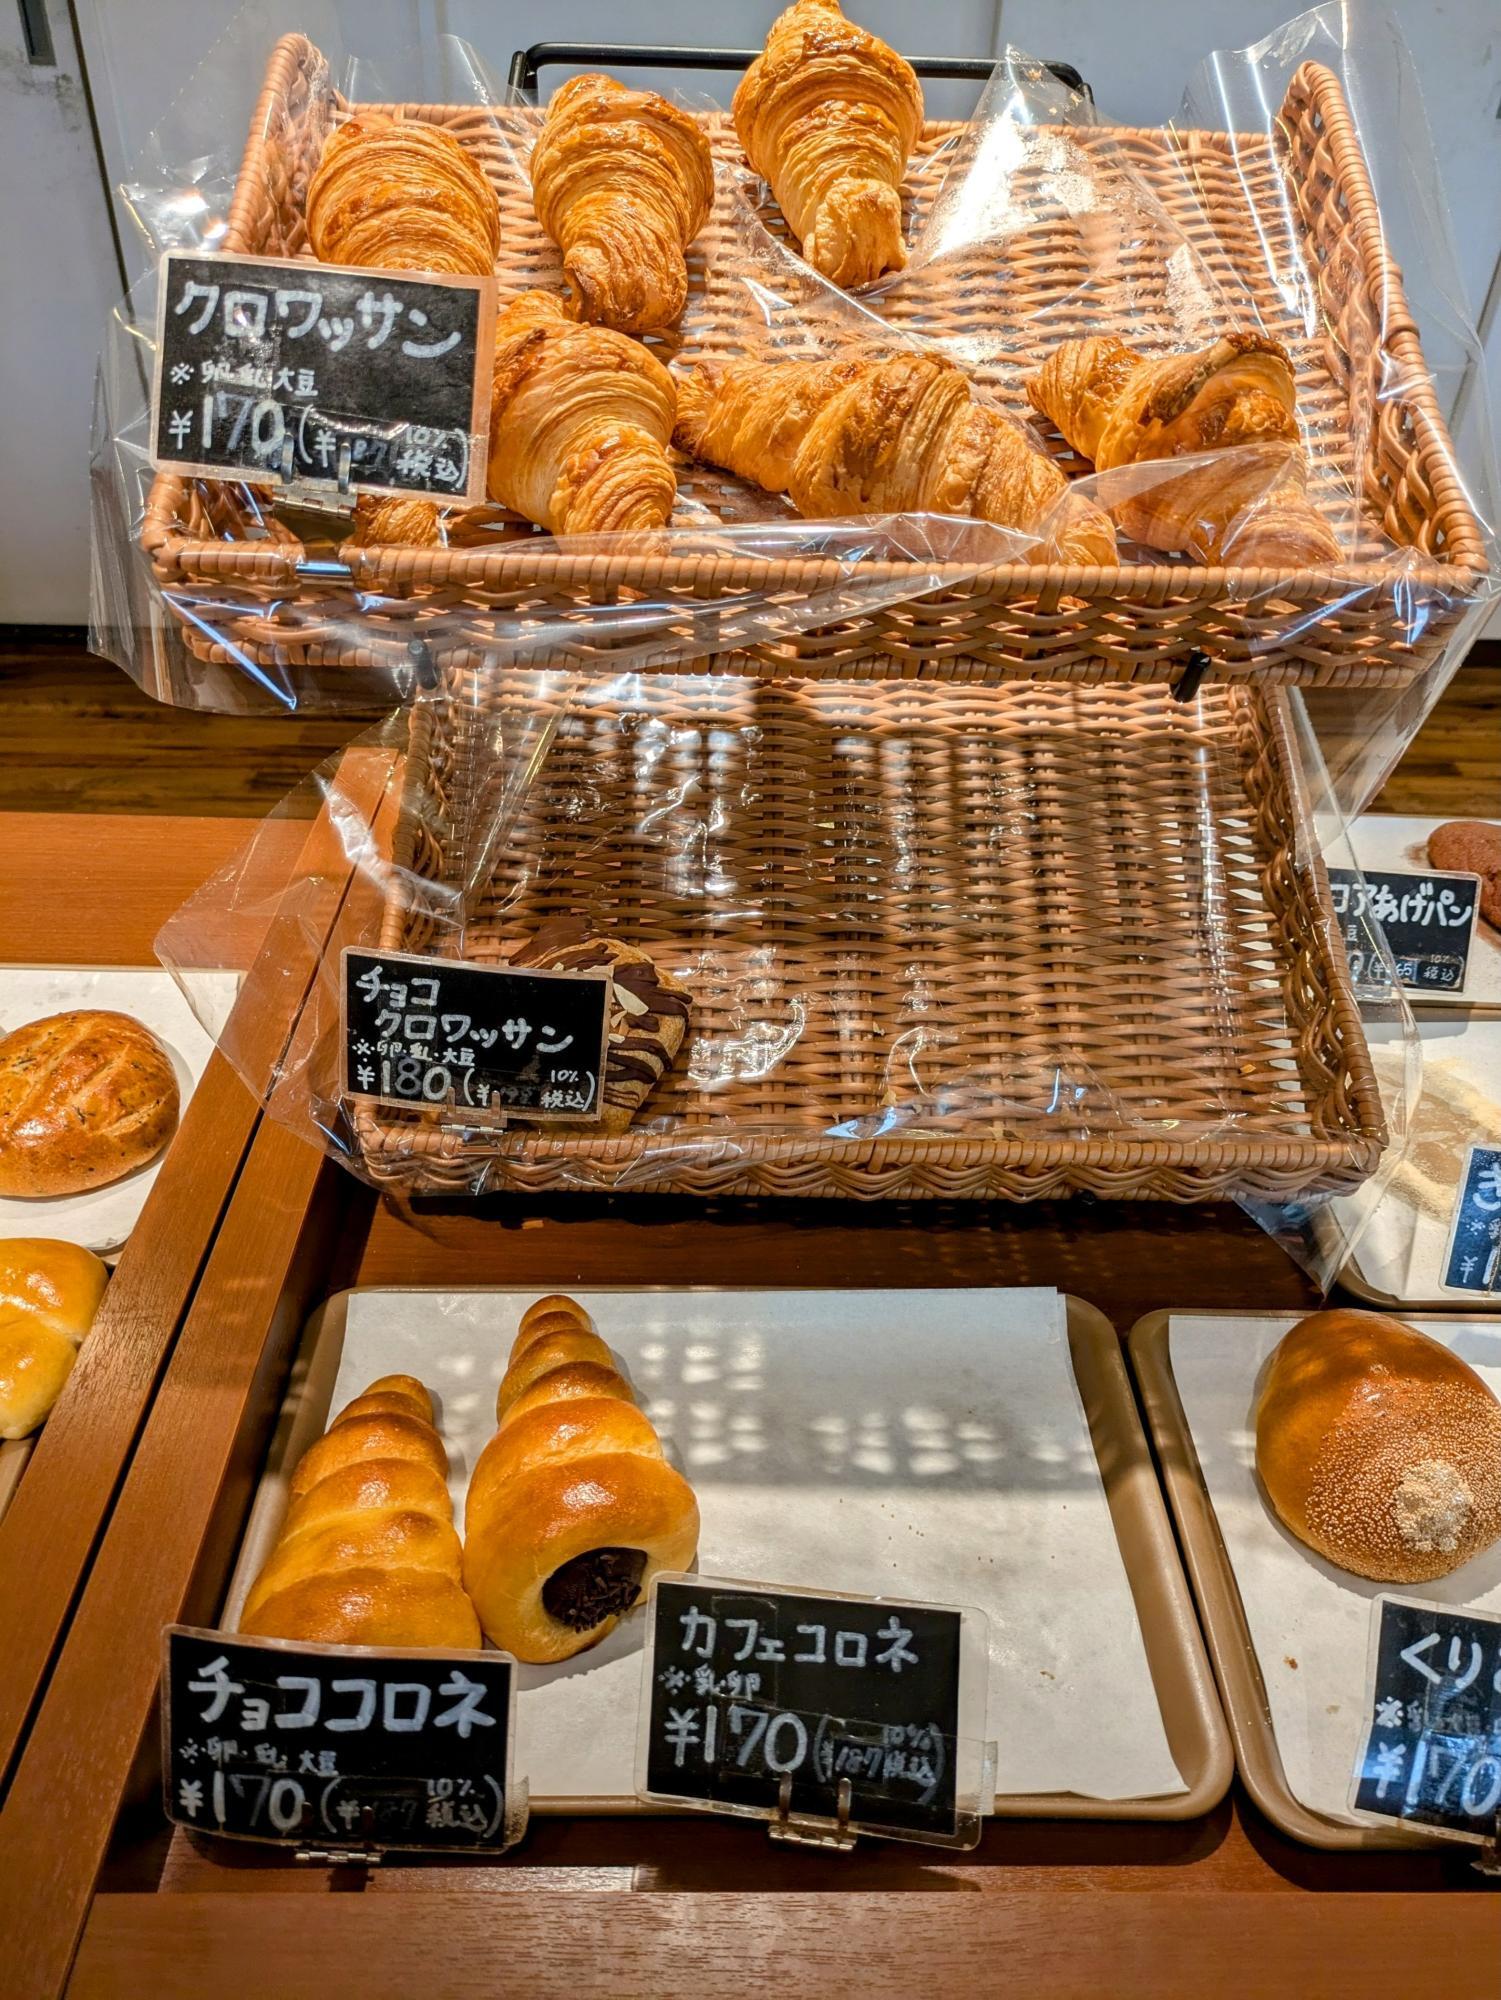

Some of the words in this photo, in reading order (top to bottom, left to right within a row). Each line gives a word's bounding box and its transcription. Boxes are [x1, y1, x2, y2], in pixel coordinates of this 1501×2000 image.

[174, 280, 462, 359] クロワッサン
[356, 965, 441, 1009] チョコ
[374, 1008, 574, 1053] クロワッサン
[679, 1605, 919, 1673] カフェコロネ
[1400, 1632, 1501, 1692] くり
[187, 1655, 497, 1739] チョココロネ
